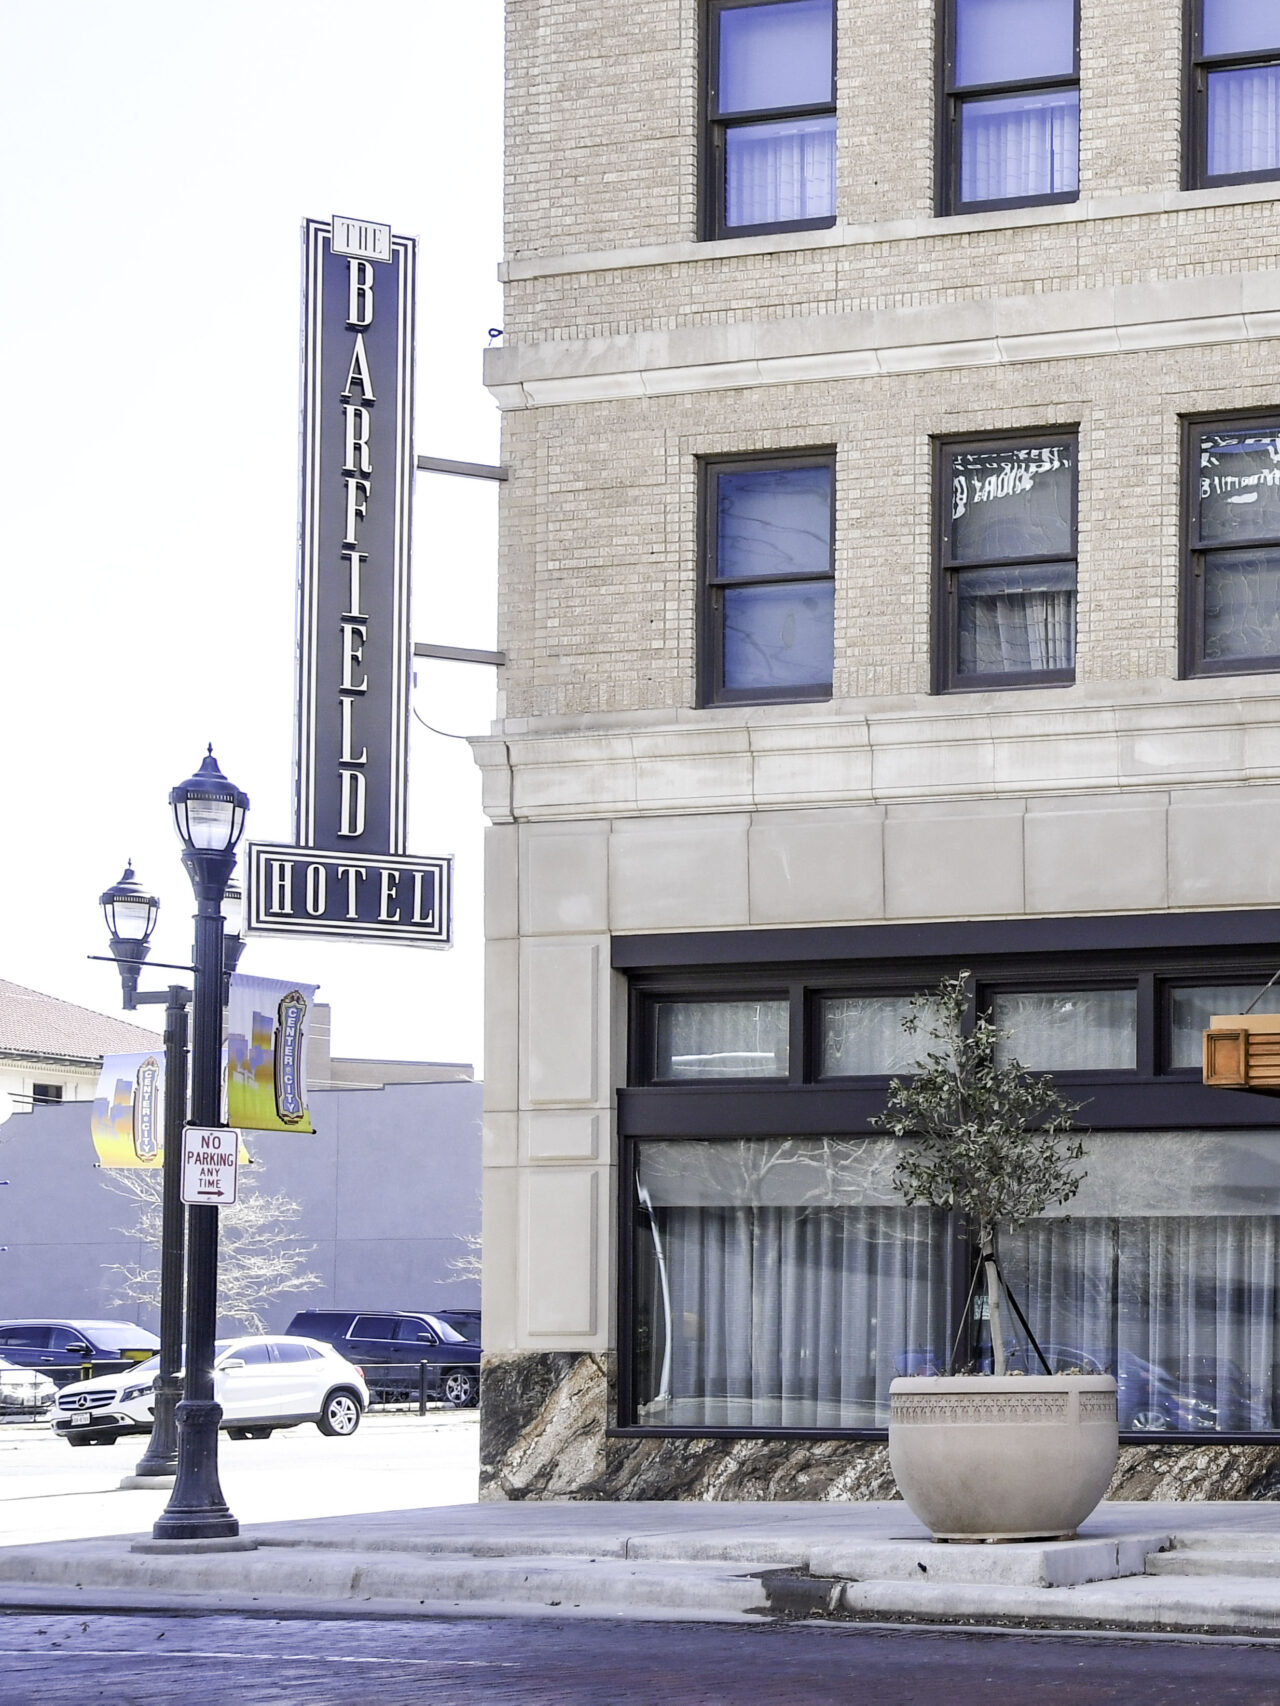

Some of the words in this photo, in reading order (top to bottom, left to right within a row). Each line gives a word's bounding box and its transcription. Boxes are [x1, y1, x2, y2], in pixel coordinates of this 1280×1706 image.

[341, 222, 382, 254] THE
[337, 257, 376, 838] BARFIELD
[269, 860, 433, 923] HOTEL
[284, 1008, 298, 1065] CENTER
[142, 1070, 153, 1115] CENTER
[284, 1075, 297, 1113] CITY
[142, 1122, 151, 1153] CITY
[201, 1135, 221, 1149] NO
[187, 1151, 234, 1167] PARKING
[200, 1167, 220, 1177] ANY
[199, 1178, 221, 1189] TIME
